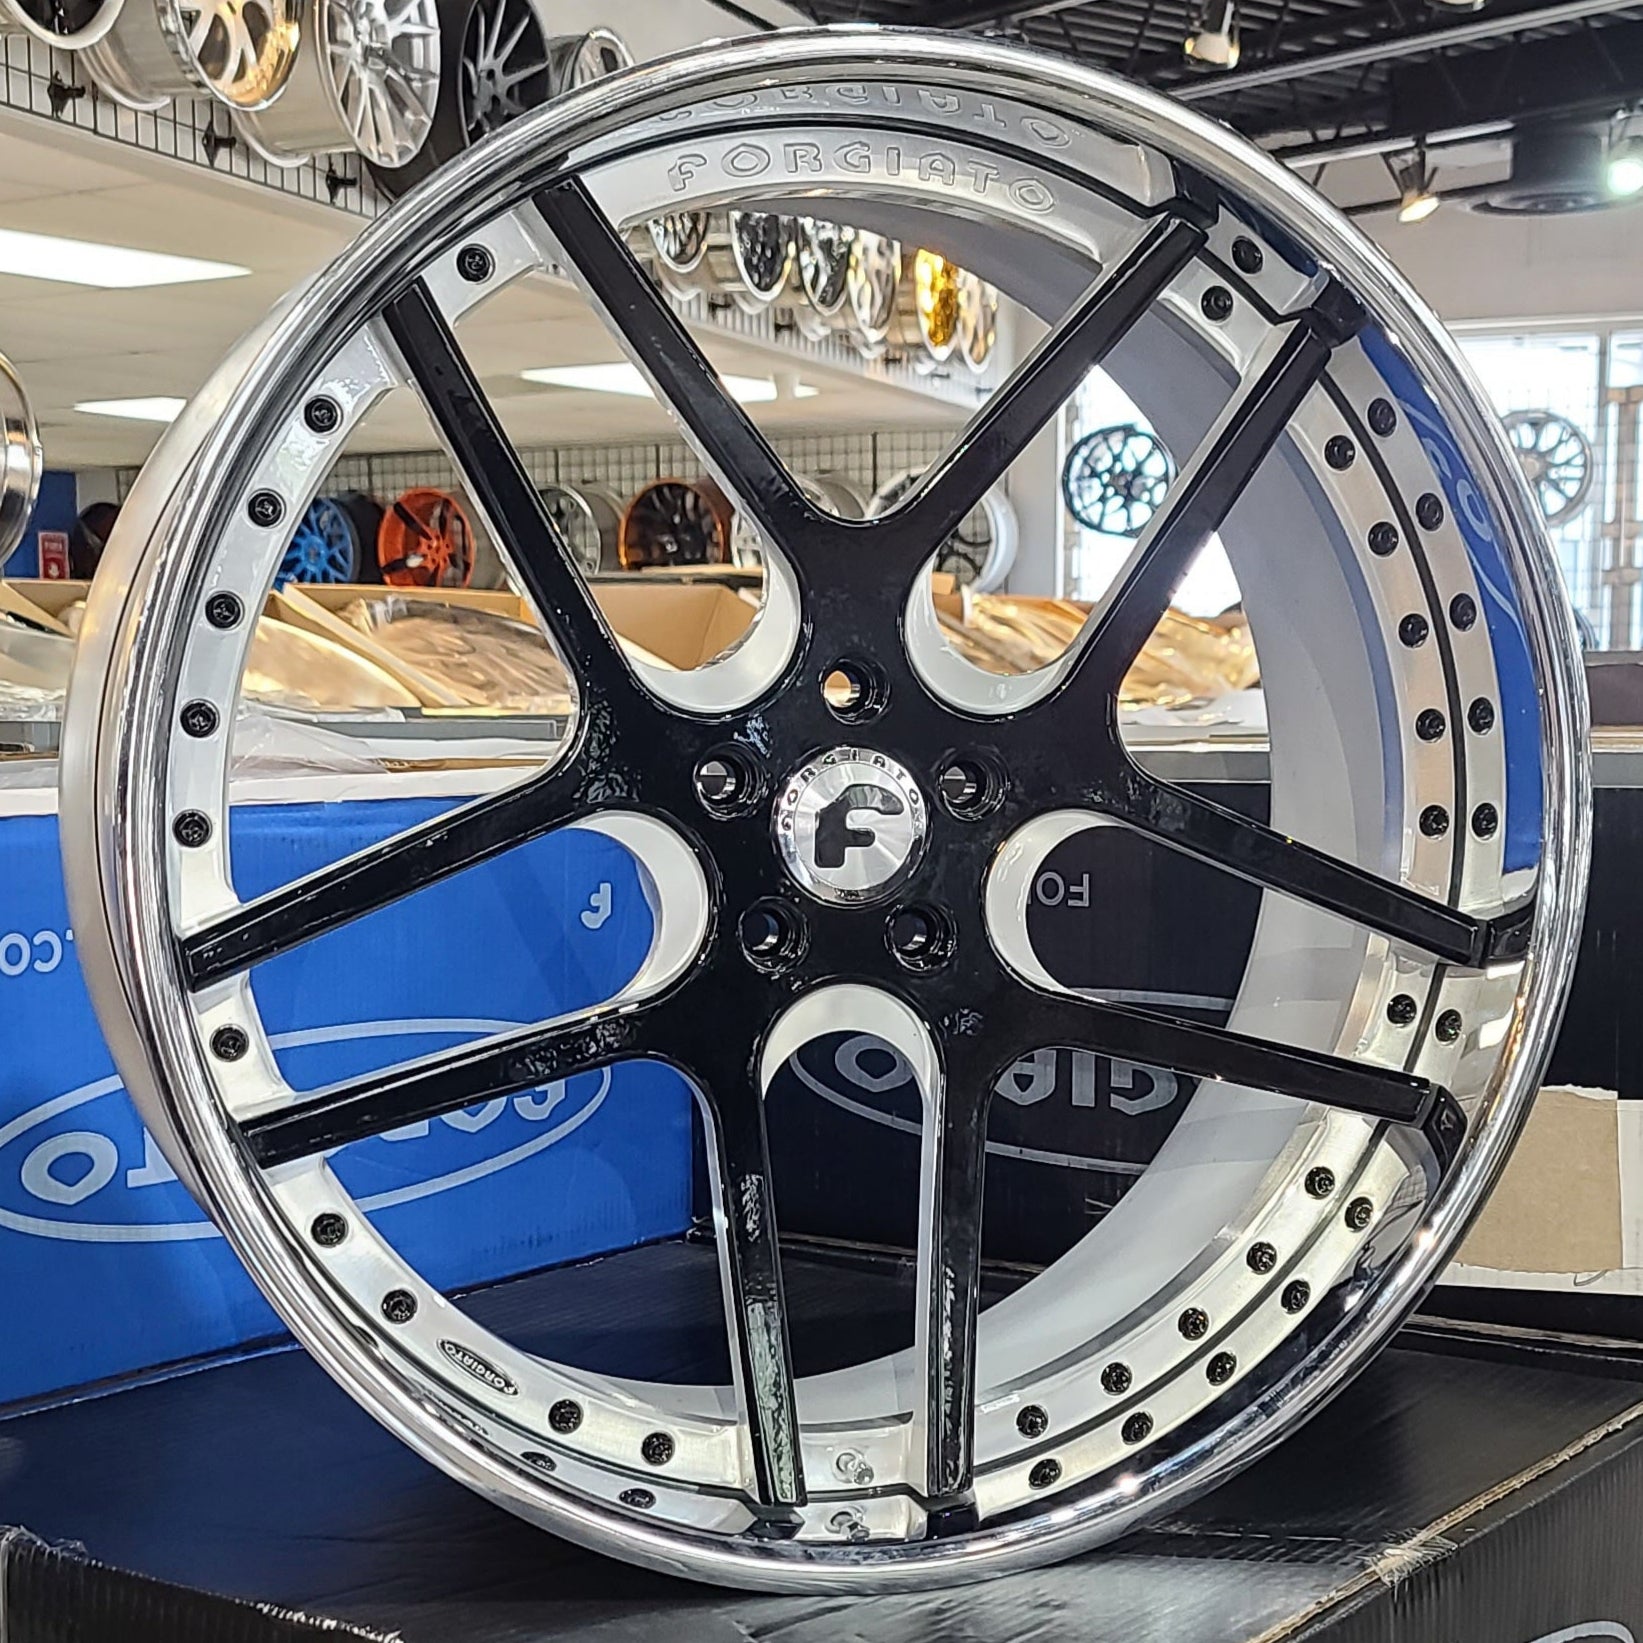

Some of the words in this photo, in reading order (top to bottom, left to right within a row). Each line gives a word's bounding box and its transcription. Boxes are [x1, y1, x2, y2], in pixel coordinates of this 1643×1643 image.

[667, 142, 1057, 213] FORGIATO
[781, 749, 919, 830] FORGIATO
[814, 783, 905, 868] F
[1027, 871, 1092, 908] FO
